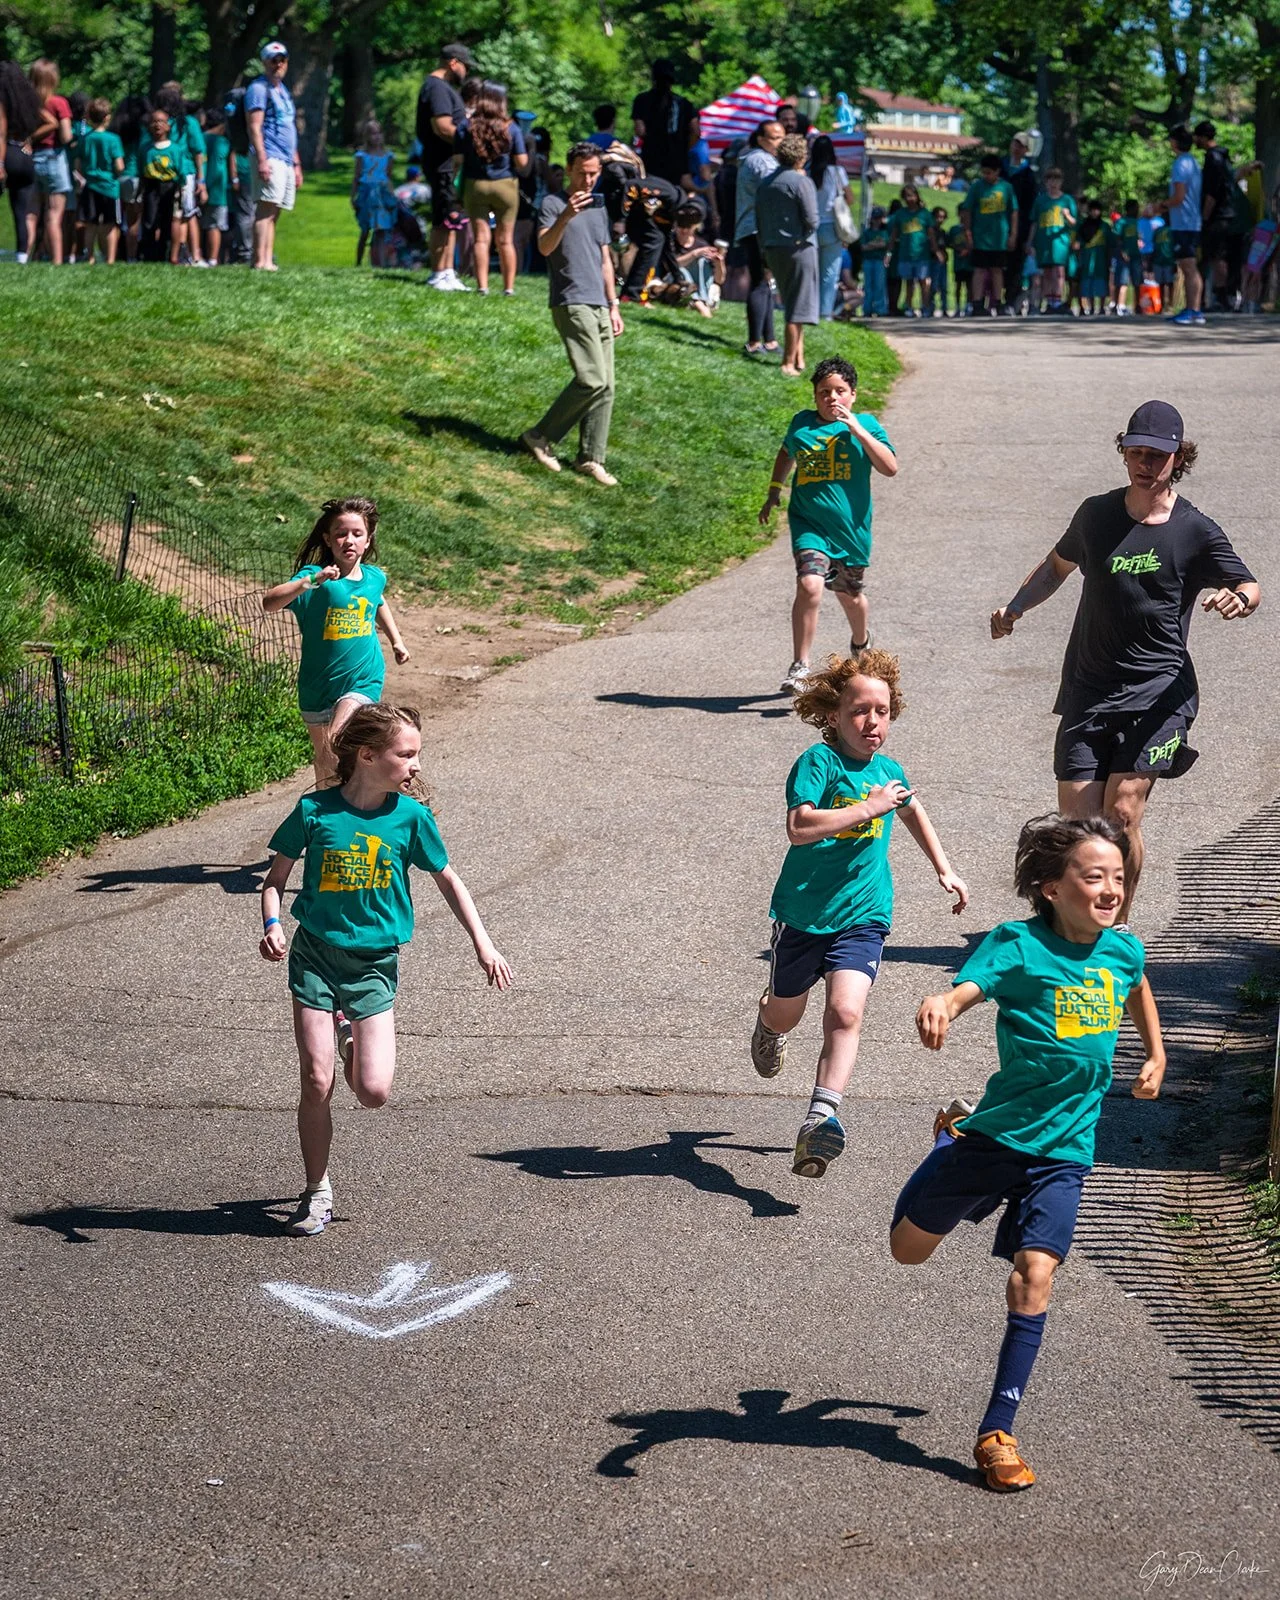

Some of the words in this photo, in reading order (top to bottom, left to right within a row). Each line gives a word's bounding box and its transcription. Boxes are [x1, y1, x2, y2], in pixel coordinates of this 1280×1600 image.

[836, 462, 851, 471] PS
[836, 472, 851, 480] 20
[328, 611, 361, 620] SOCIAL
[326, 618, 360, 628] JUSTICE
[338, 627, 359, 635] RUN
[324, 854, 371, 867] SOCIAL
[323, 863, 371, 877] JUSTICE
[375, 868, 393, 880] PS
[338, 875, 370, 886] RUN
[373, 878, 391, 889] 20
[1056, 991, 1110, 1004] SOCIAL
[1054, 1001, 1111, 1018] JUSTICE
[1079, 1015, 1112, 1028] RUN
